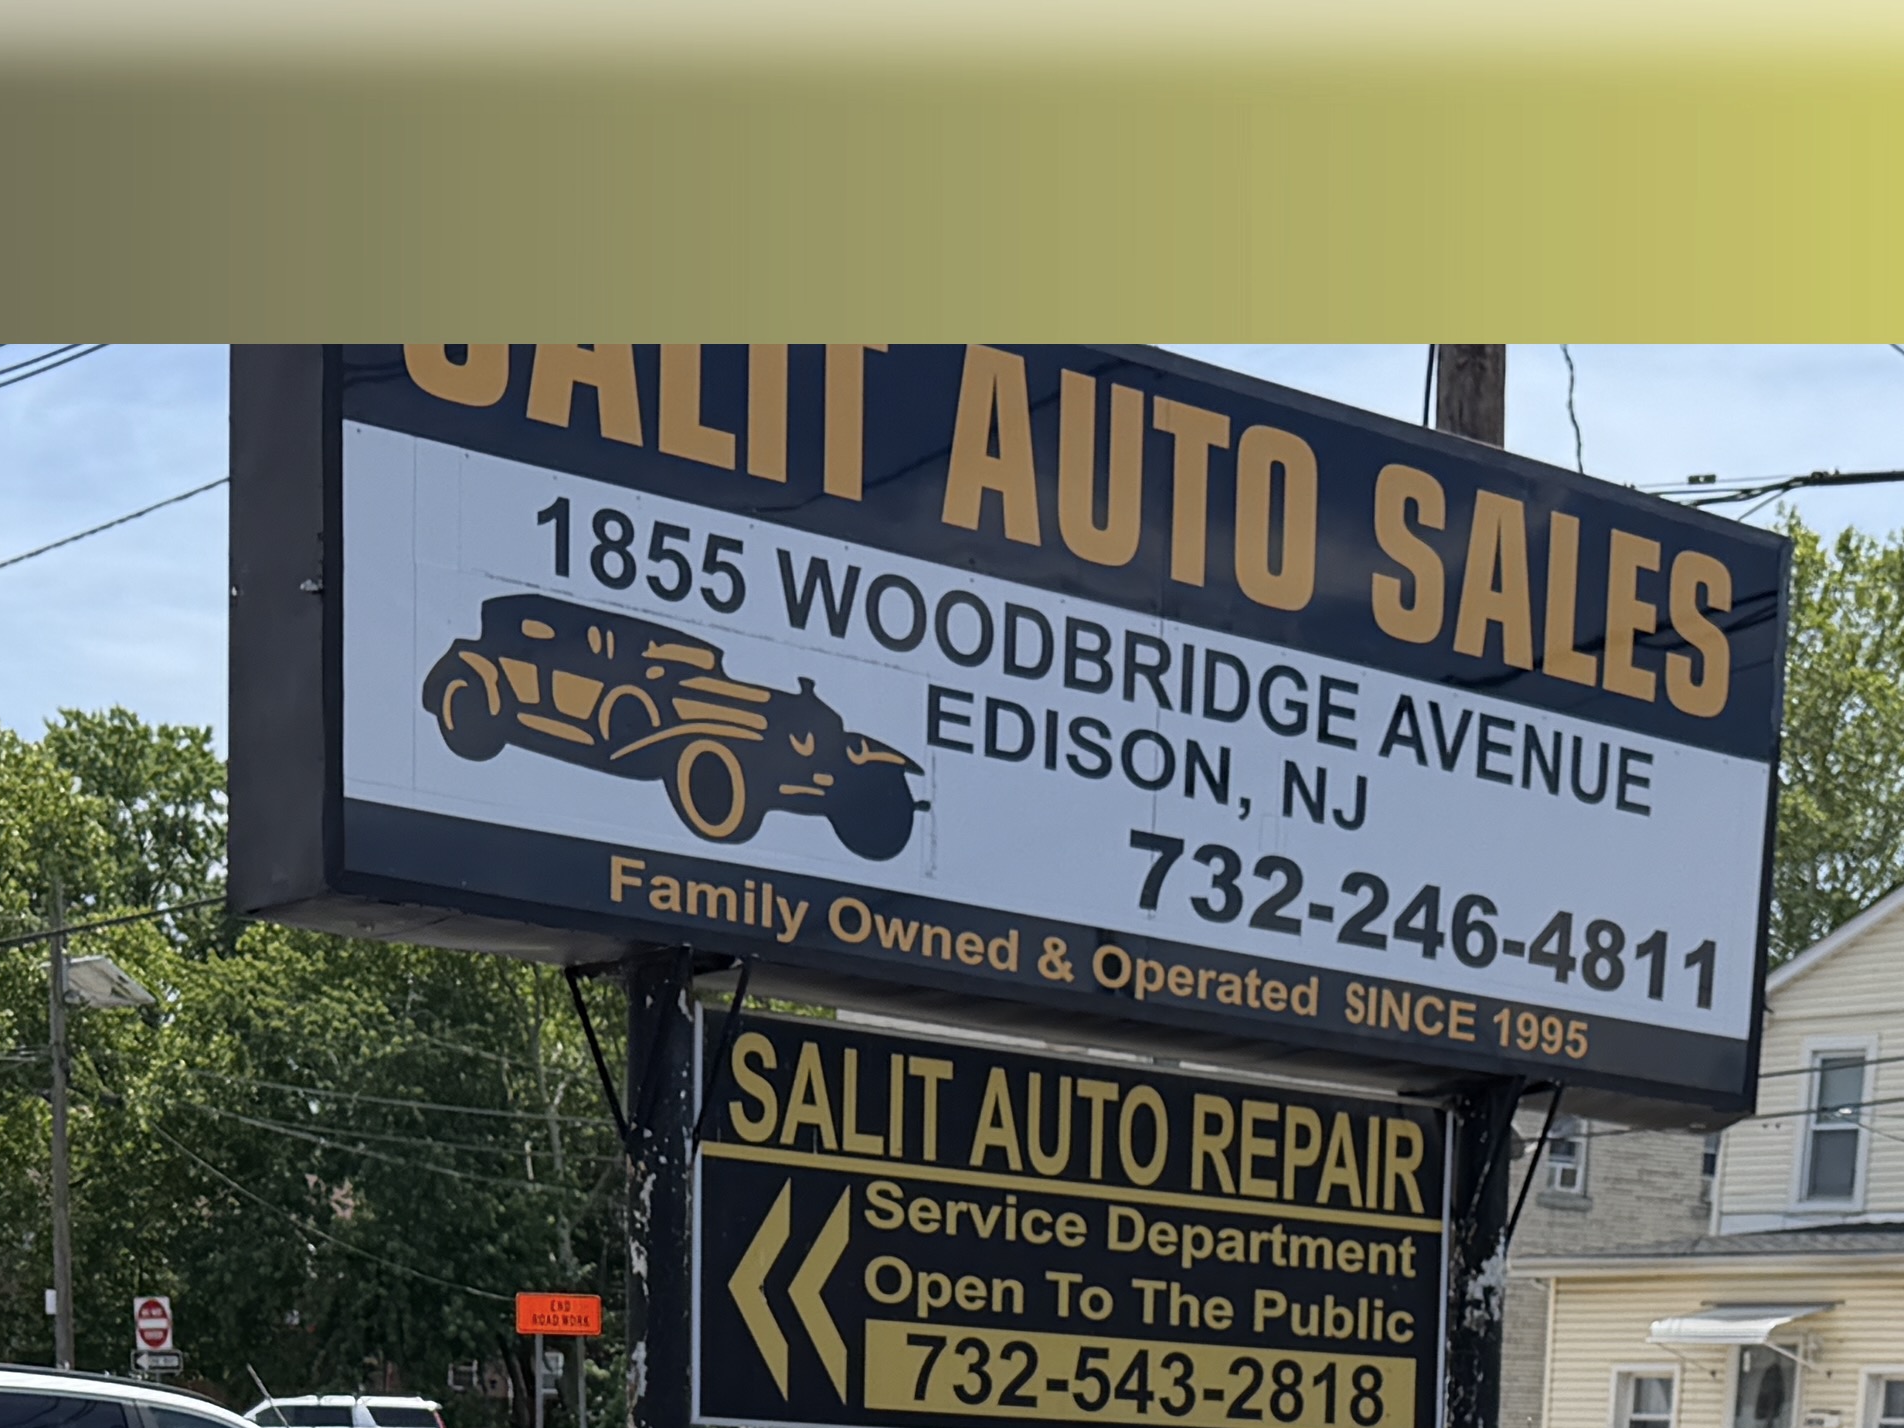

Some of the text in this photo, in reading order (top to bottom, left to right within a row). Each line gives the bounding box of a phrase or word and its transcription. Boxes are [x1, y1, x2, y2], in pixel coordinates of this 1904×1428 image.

[942, 344, 1319, 612] AUTO
[1371, 463, 1733, 718] SALES
[537, 496, 1655, 817] 1855 WOODBRIDGE AVENUE
[926, 683, 1370, 831] EDISON, NJ
[609, 854, 1590, 1059] Family Owned & Operated SINCE 1995
[1128, 828, 1717, 1010] 732-246-4811
[728, 1031, 1425, 1215] SALIT AUTO REPAIR
[863, 1180, 1418, 1279] Service Department
[863, 1255, 1416, 1344] Open To The Public
[532, 1313, 590, 1327] ROAD WORK
[904, 1333, 1386, 1428] 732-543-2818
